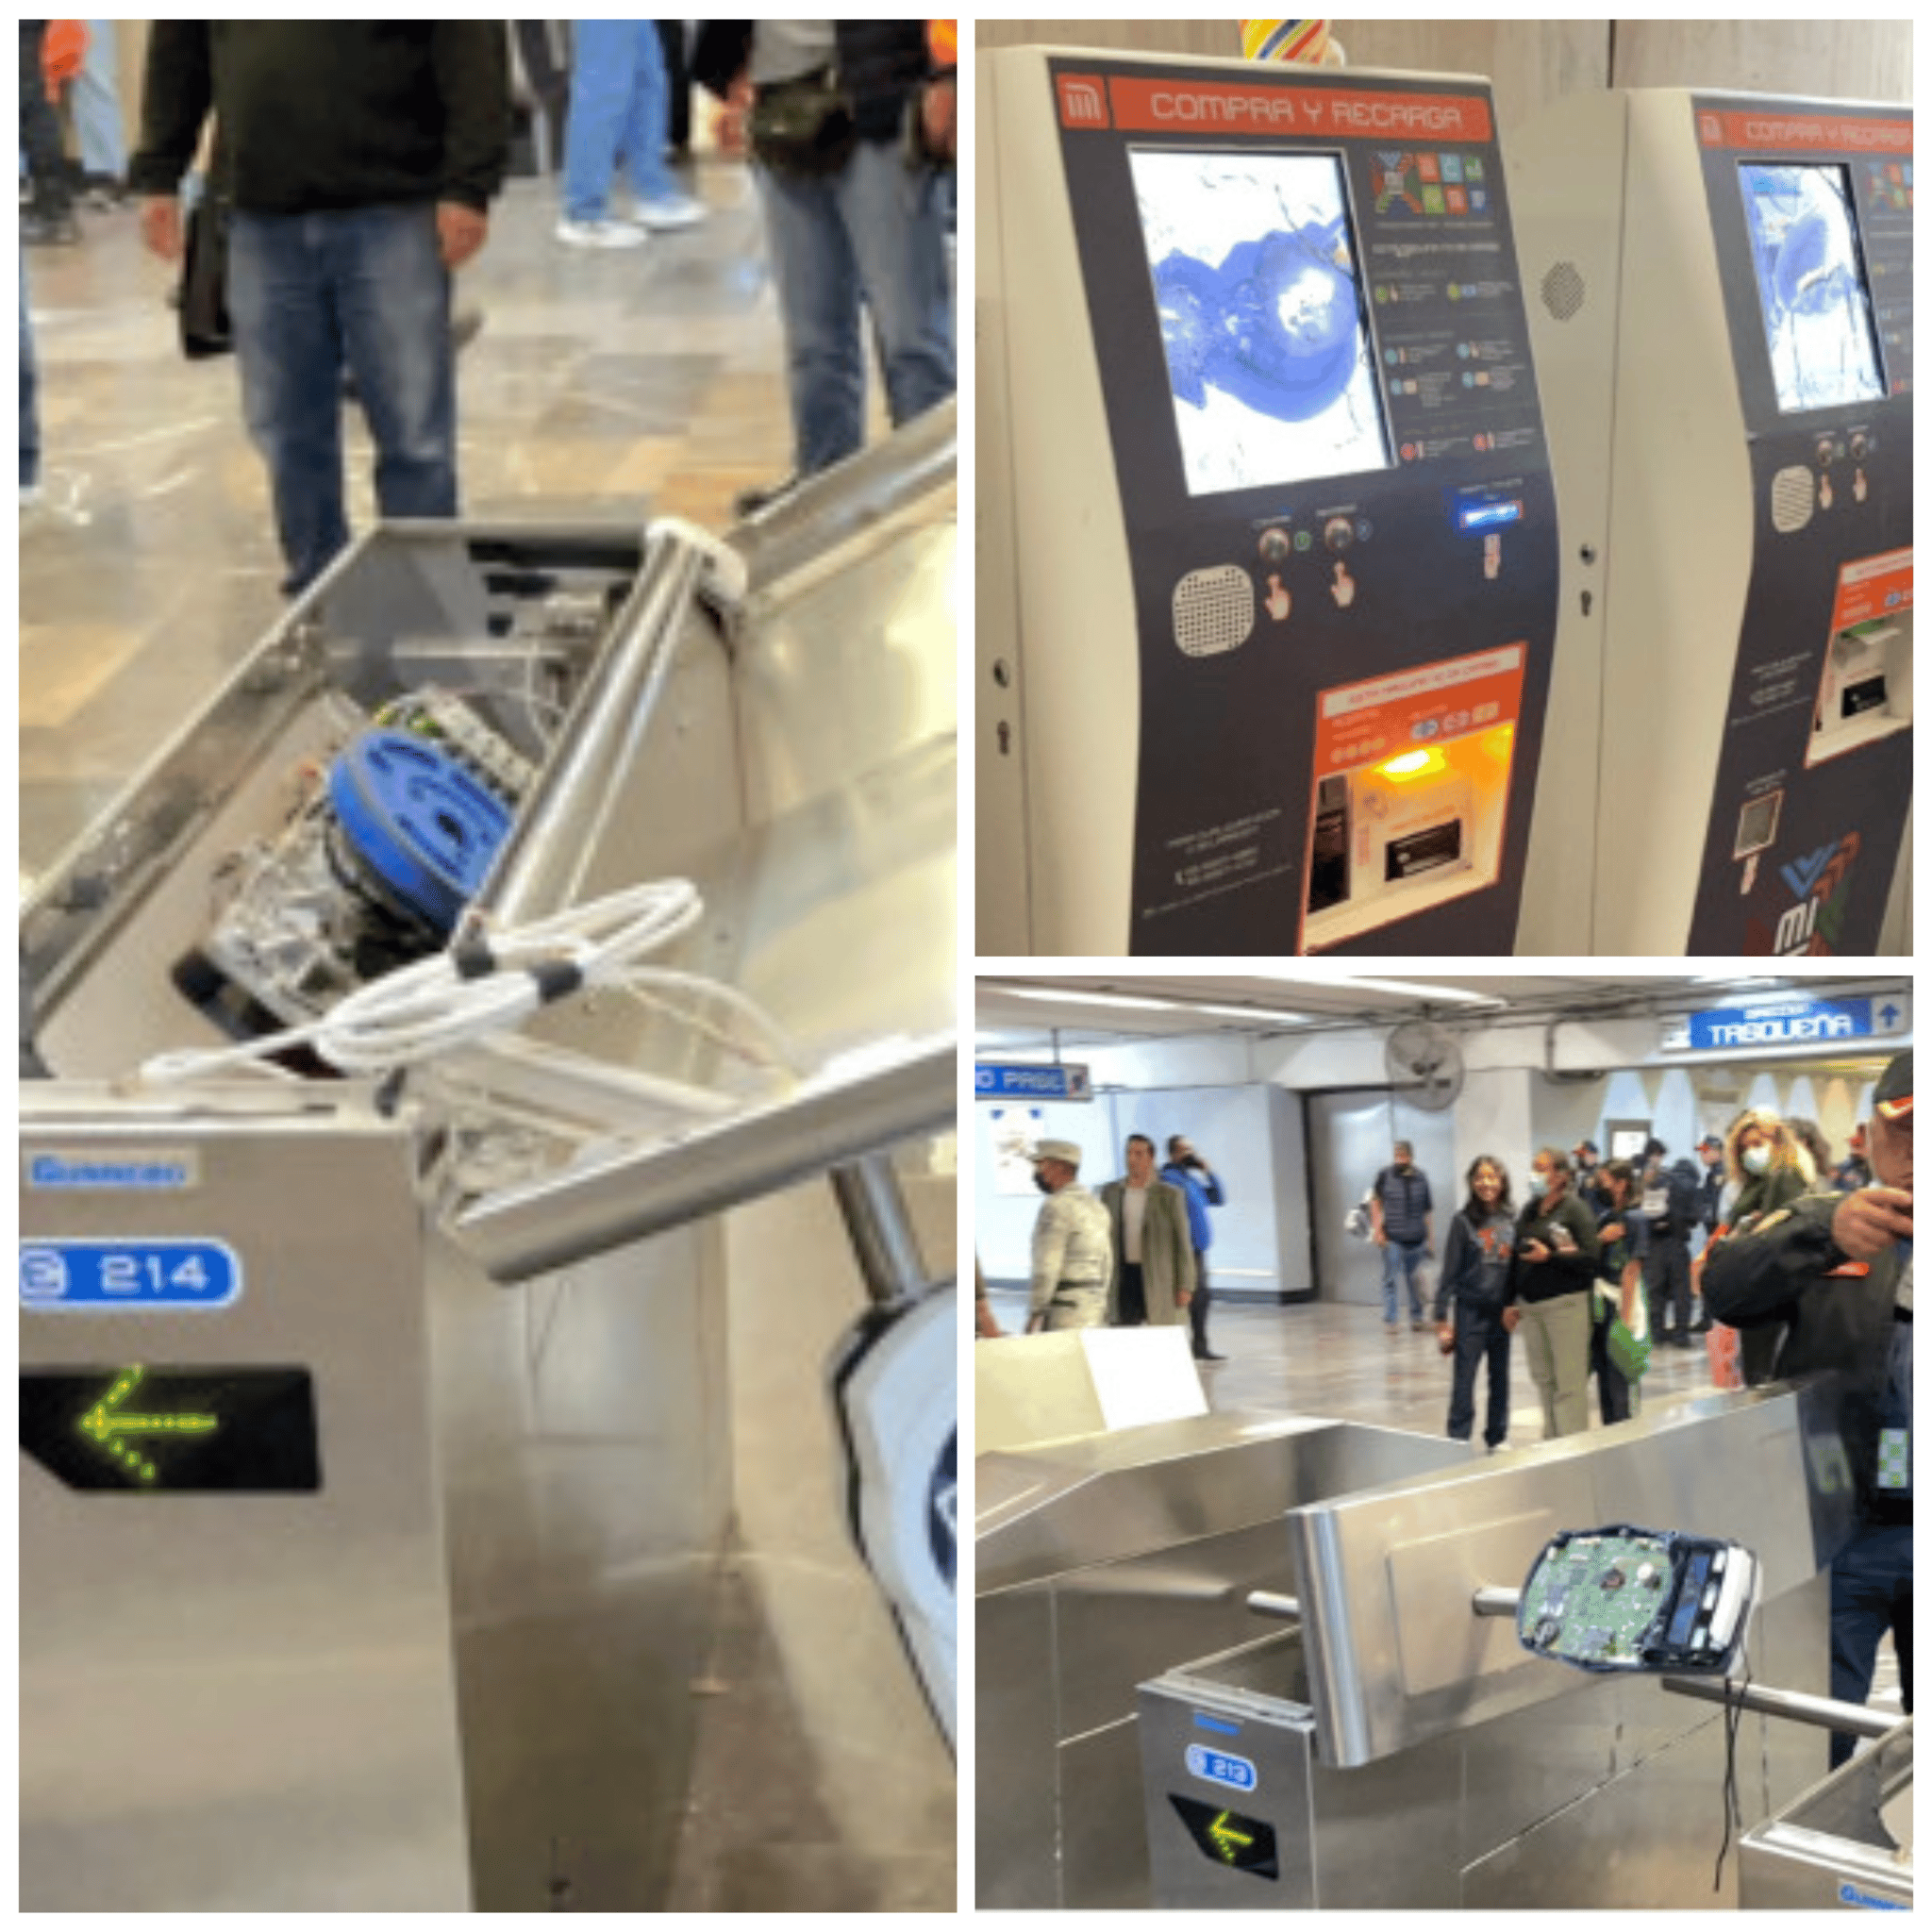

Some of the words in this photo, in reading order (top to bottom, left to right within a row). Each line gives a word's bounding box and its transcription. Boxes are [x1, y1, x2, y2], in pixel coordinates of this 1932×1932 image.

[1150, 92, 1296, 125] COMPRA
[1303, 98, 1323, 127] Y
[1331, 99, 1463, 130] RECARGA
[98, 1254, 210, 1293] 214
